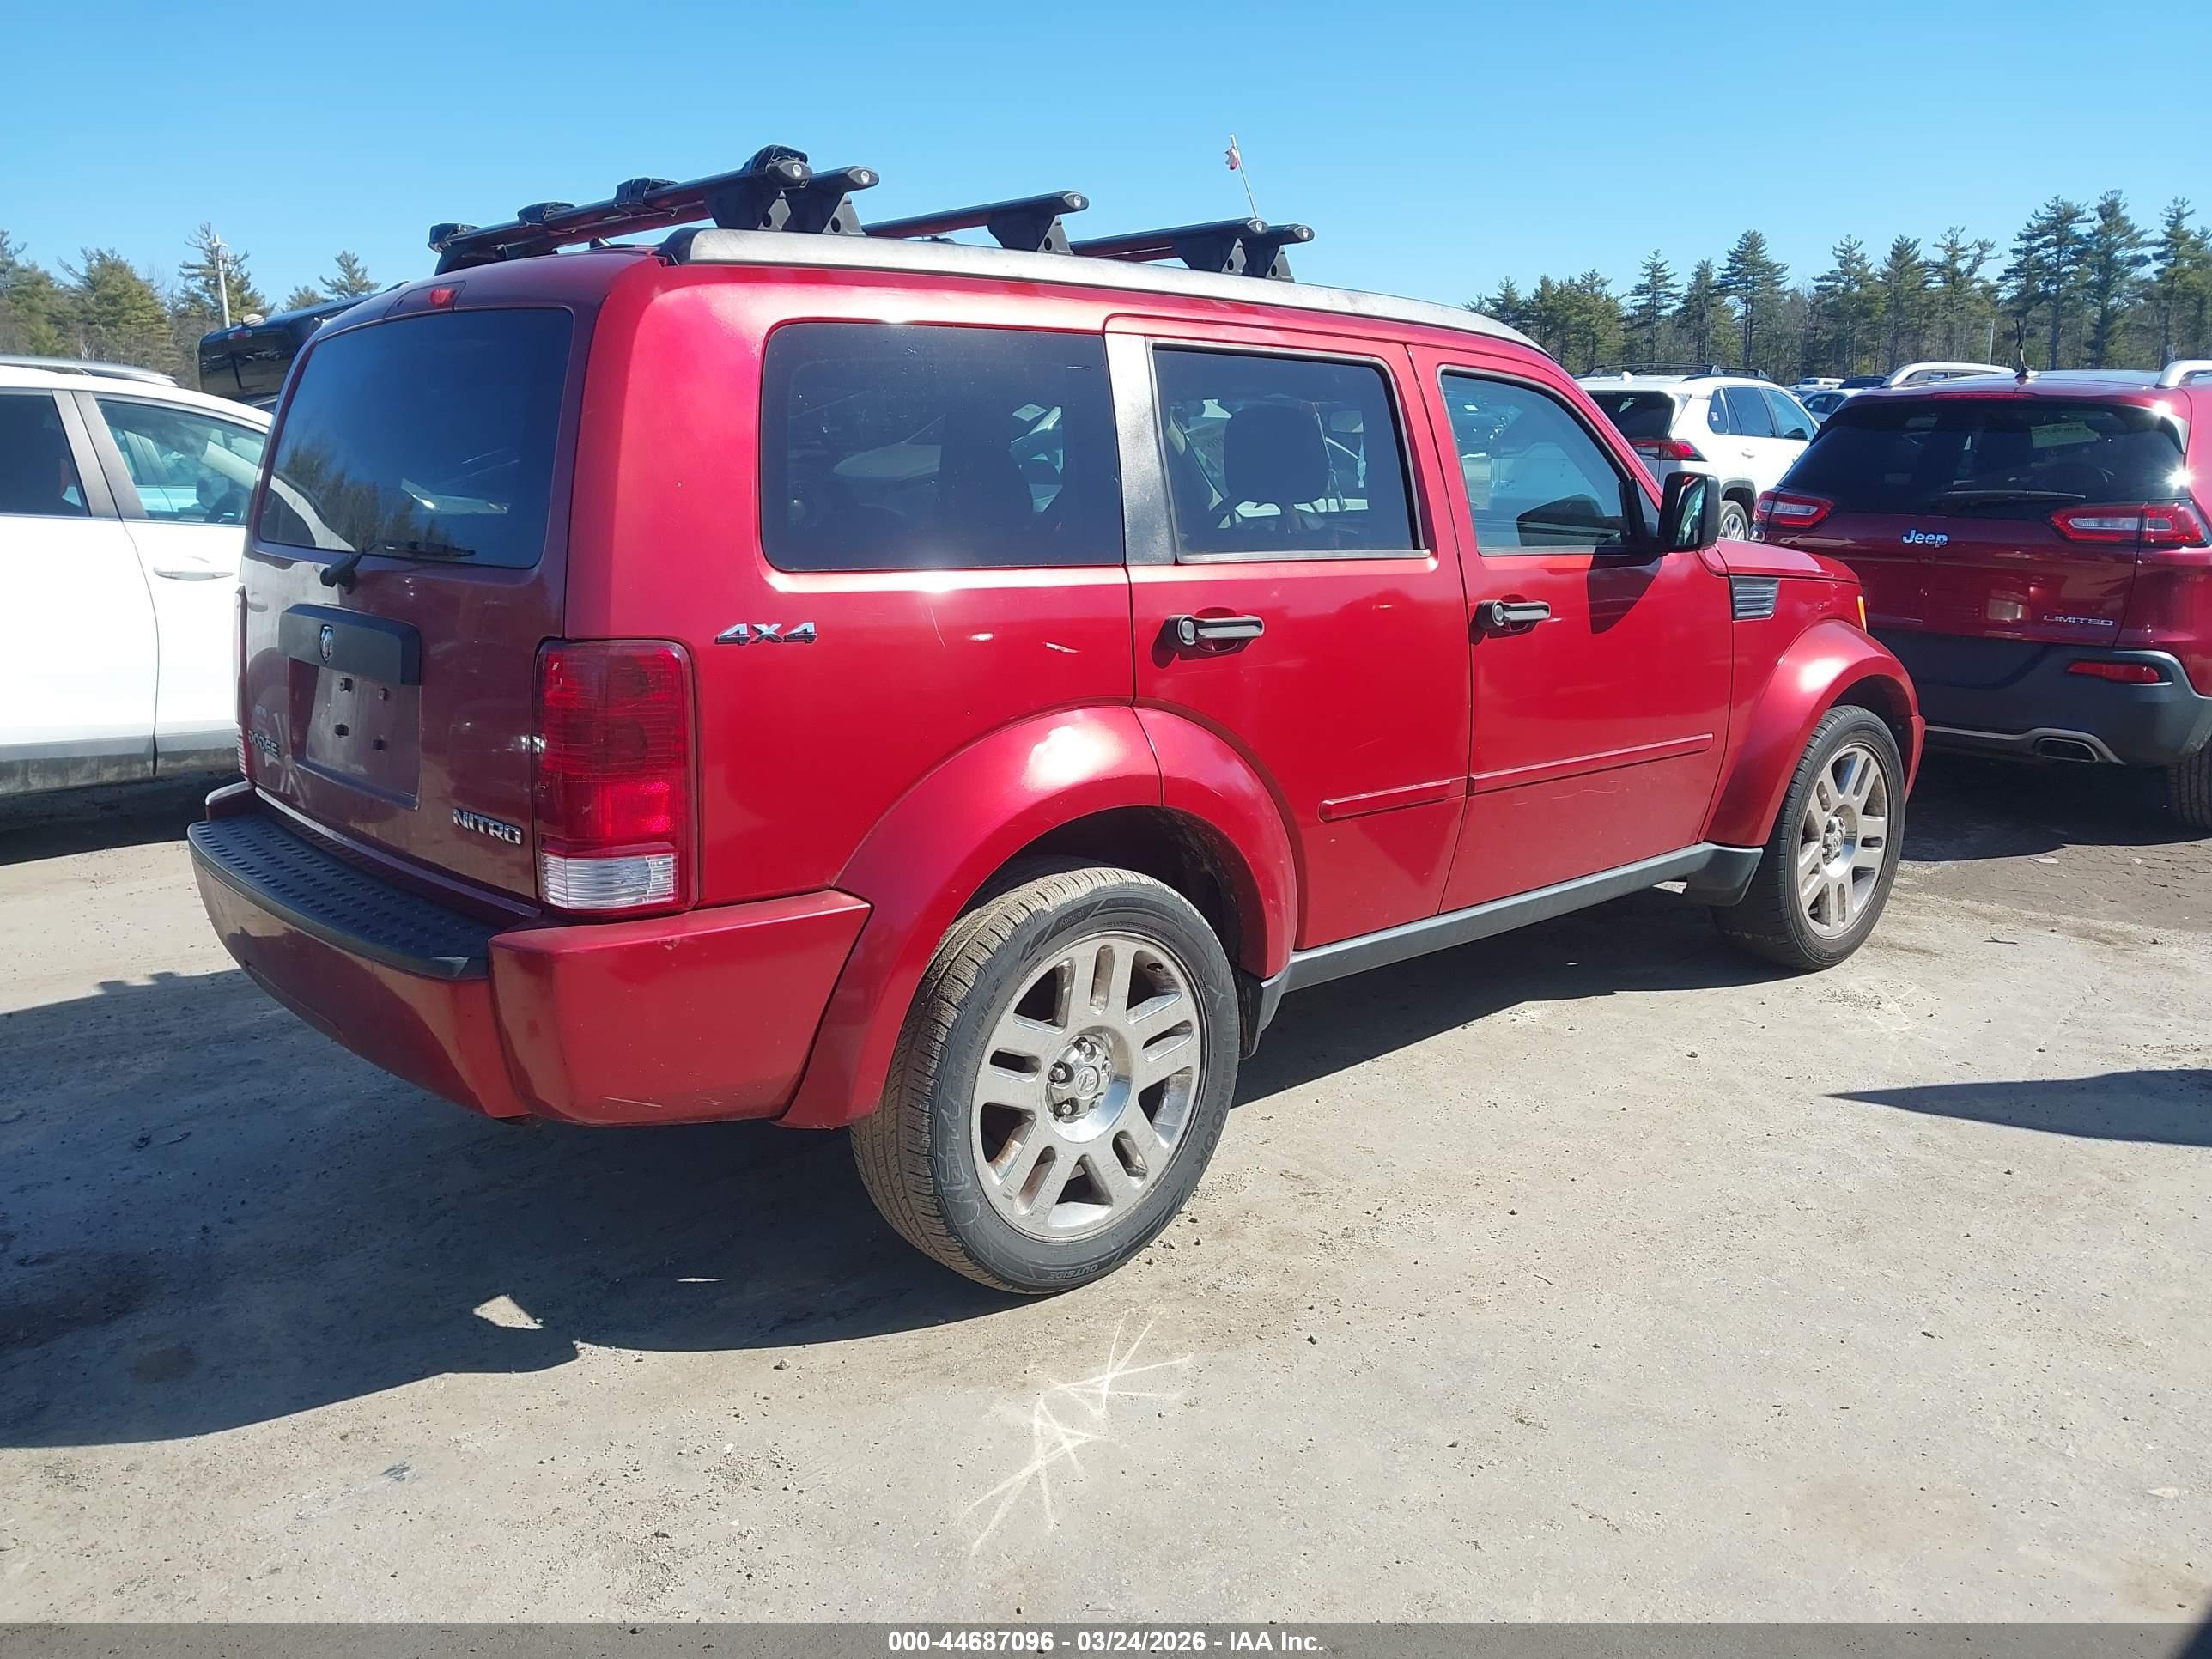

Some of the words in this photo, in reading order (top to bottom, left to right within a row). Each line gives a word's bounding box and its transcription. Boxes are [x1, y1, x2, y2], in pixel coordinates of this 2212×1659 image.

[1902, 529, 1948, 549] Jeep
[2043, 615, 2114, 626] LIMITED
[714, 622, 817, 646] 4X4
[247, 729, 280, 758] DODGE
[453, 808, 522, 845] NITRO
[1047, 1263, 1099, 1279] OUTSIDE
